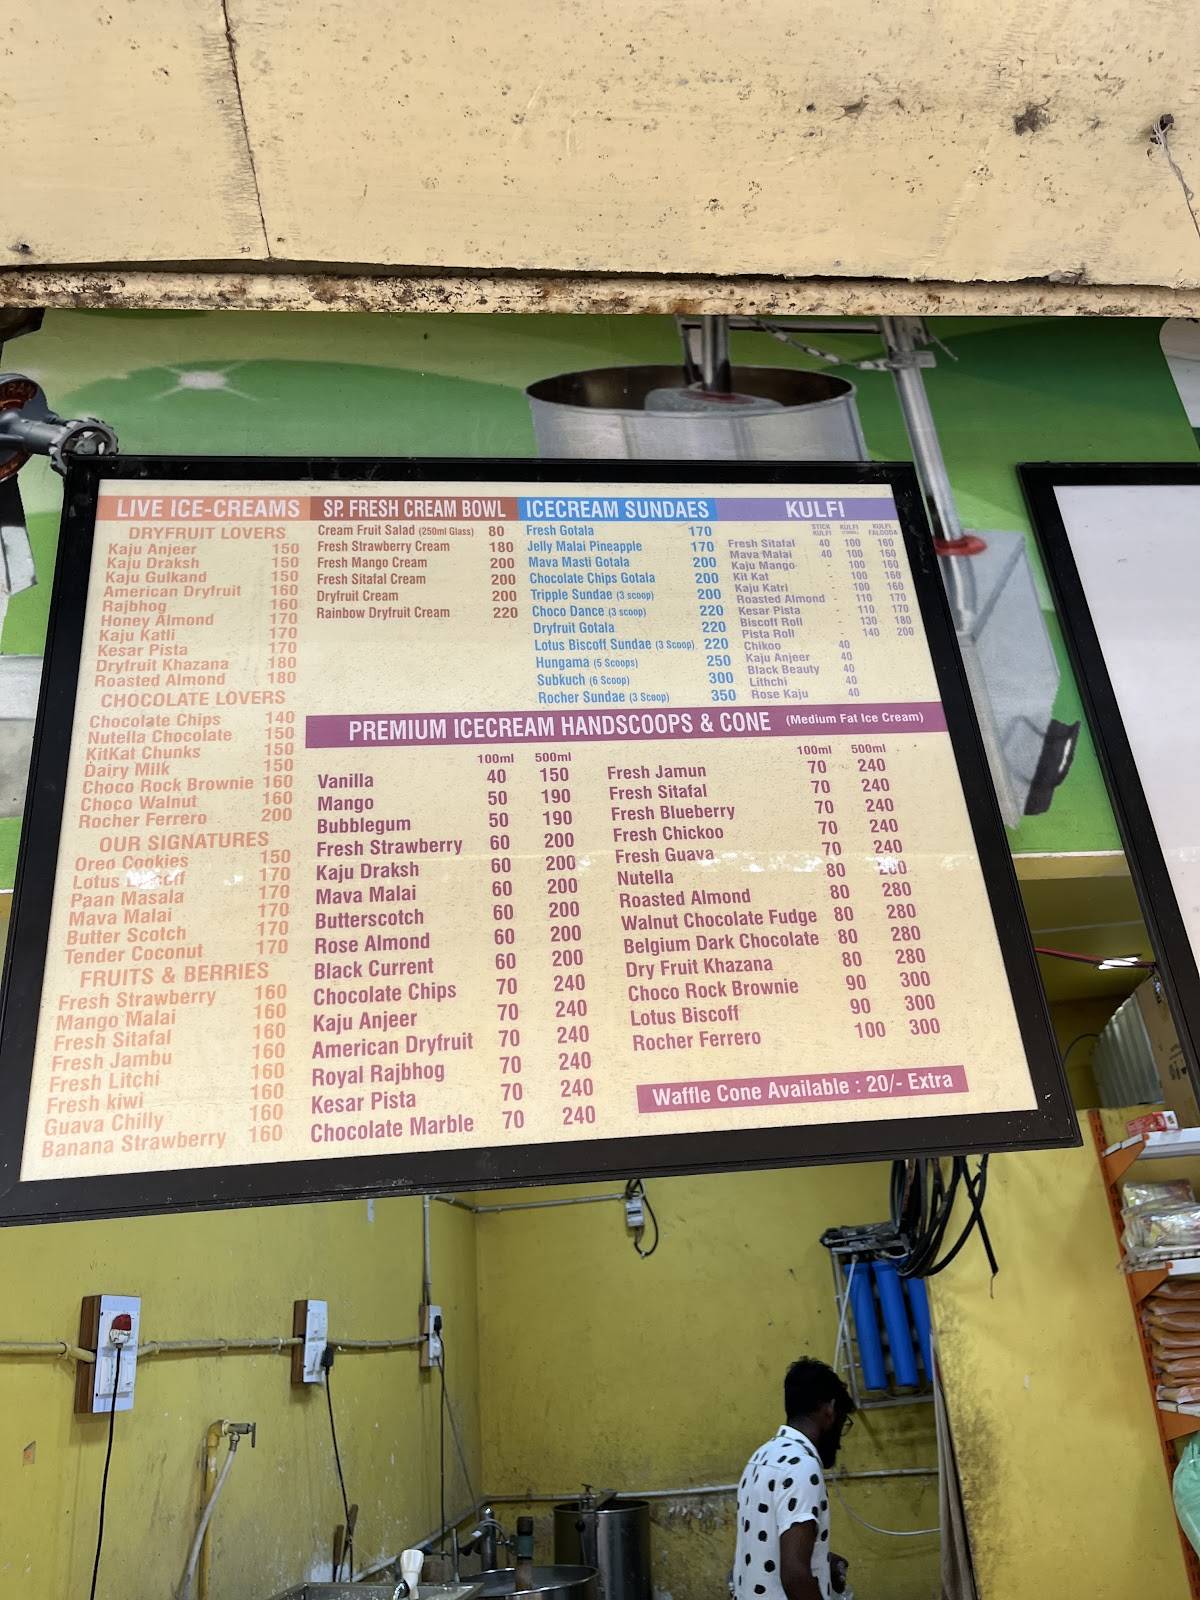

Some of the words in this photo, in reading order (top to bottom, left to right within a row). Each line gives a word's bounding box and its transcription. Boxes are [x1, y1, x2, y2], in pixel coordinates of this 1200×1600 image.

[116, 498, 163, 517] LIVE
[170, 499, 300, 517] ICE-CREAMS
[323, 499, 344, 517] SP.
[349, 499, 399, 517] FRESH
[403, 499, 457, 517] CREAM
[461, 499, 506, 517] BOWL
[526, 499, 619, 518] ICECREAM
[623, 500, 709, 518] SUNDAES
[784, 500, 845, 518] KULFI
[128, 526, 216, 540] DRYFRUIT
[220, 526, 286, 540] LOVERS
[317, 524, 353, 536] Cream
[356, 524, 382, 536] Fruit
[384, 524, 415, 536] Salad
[418, 526, 447, 536] (250ml
[448, 526, 474, 537] Glass)
[487, 525, 505, 537] 80
[317, 540, 348, 552] Fresh
[351, 539, 412, 555] Strawberry
[414, 539, 450, 552] Cream
[488, 541, 514, 553] 180
[526, 540, 553, 555] Jelly
[555, 540, 586, 552] Malai
[588, 540, 643, 555] Pineapple
[690, 541, 715, 552] 170
[317, 556, 348, 568] Fresh
[351, 556, 389, 571] Mango
[391, 556, 428, 568] Cream
[489, 557, 515, 569] 200
[529, 571, 584, 584] Chocolate
[586, 571, 618, 587] Chips
[619, 571, 656, 583] Gotala
[694, 572, 719, 584] 200
[529, 588, 569, 603] Tripple
[570, 587, 613, 600] Sundae
[615, 590, 625, 601] (3
[626, 591, 655, 601] scoop)
[696, 587, 722, 600] 200
[316, 606, 365, 619] Rainbow
[368, 605, 411, 622] Dryfruit
[413, 605, 450, 618] Cream
[492, 606, 519, 619] 220
[856, 603, 876, 614] 110
[890, 603, 910, 613] 170
[99, 611, 151, 631] Honey
[154, 610, 214, 626] Almond
[268, 611, 298, 625] 170
[859, 615, 878, 625] 130
[893, 615, 912, 625] 180
[861, 627, 881, 637] 140
[895, 625, 915, 636] 200
[96, 641, 145, 657] Kesar
[148, 641, 188, 656] Pista
[267, 640, 297, 654] 170
[534, 638, 565, 651] Lotus
[568, 638, 607, 651] Biscoff
[609, 637, 652, 650] Sundae
[654, 639, 664, 651] (3
[665, 639, 695, 651] Scoop)
[703, 637, 730, 650] 220
[837, 639, 851, 649] 40
[535, 655, 590, 673] Hungama
[592, 658, 602, 669] (5
[603, 657, 639, 669] Scoops)
[705, 654, 732, 667] 250
[842, 662, 856, 673] 40
[93, 673, 161, 688] Roasted
[164, 672, 226, 686] Almond
[266, 670, 297, 684] 180
[100, 691, 209, 708] CHOCOLATE
[215, 689, 286, 706] LOVERS
[349, 718, 446, 741] PREMIUM
[453, 716, 555, 738] ICECREAM
[560, 713, 694, 736] HANDSCOOPS
[698, 712, 714, 732] &
[718, 711, 771, 732] CONE
[785, 713, 837, 725] (Medium
[839, 712, 858, 723] Fat
[860, 712, 879, 723] Ice
[880, 711, 925, 724] Cream)
[87, 729, 147, 745] Nutella
[151, 727, 233, 743] Chocolate
[264, 725, 295, 740] 150
[476, 753, 514, 764] 100ml
[534, 751, 572, 763] 500ml
[796, 744, 832, 755] 100ml
[850, 742, 886, 754] 500ml
[316, 772, 374, 789] Vanilla
[485, 768, 507, 784] 40
[538, 766, 569, 782] 150
[606, 765, 650, 780] Fresh
[653, 763, 707, 779] Jamun
[806, 759, 828, 774] 70
[856, 757, 887, 772] 240
[317, 794, 374, 815] Mango
[487, 789, 508, 806] 50
[540, 788, 571, 804] 190
[316, 816, 411, 837] Bubblegum
[488, 811, 509, 828] 50
[541, 809, 573, 826] 190
[98, 835, 142, 853] OUR
[147, 831, 270, 851] SIGNATURES
[314, 908, 424, 929] Butterscotch
[492, 903, 514, 921] 60
[548, 900, 580, 918] 200
[620, 913, 679, 931] Walnut
[682, 909, 764, 928] Chocolate
[767, 906, 818, 928] Fudge
[832, 905, 855, 922] 80
[885, 902, 917, 919] 280
[66, 927, 121, 946] Butter
[126, 924, 187, 943] Scotch
[256, 919, 289, 937] 170
[62, 946, 126, 965] Tender
[130, 942, 204, 961] Coconut
[254, 938, 289, 955] 170
[625, 960, 656, 982] Dry
[659, 958, 699, 976] Fruit
[702, 954, 774, 974] Khazana
[840, 950, 863, 968] 80
[894, 947, 927, 965] 280
[79, 967, 154, 988] FRUITS
[160, 965, 176, 985] &
[183, 961, 269, 983] BERRIES
[311, 1036, 399, 1059] American
[405, 1032, 474, 1058] Dryfruit
[497, 1028, 520, 1048] 70
[556, 1024, 590, 1044] 240
[632, 1031, 695, 1052] Rocher
[698, 1027, 762, 1048] Ferrero
[853, 1020, 887, 1039] 100
[908, 1017, 941, 1035] 300
[311, 1092, 365, 1114] Kesar
[370, 1089, 416, 1110] Pista
[500, 1081, 523, 1102] 70
[559, 1077, 594, 1098] 240
[652, 1085, 711, 1107] Waffle
[716, 1082, 762, 1102] Cone
[765, 1076, 850, 1099] Available
[865, 1073, 903, 1092] 20/-
[907, 1069, 953, 1090] Extra
